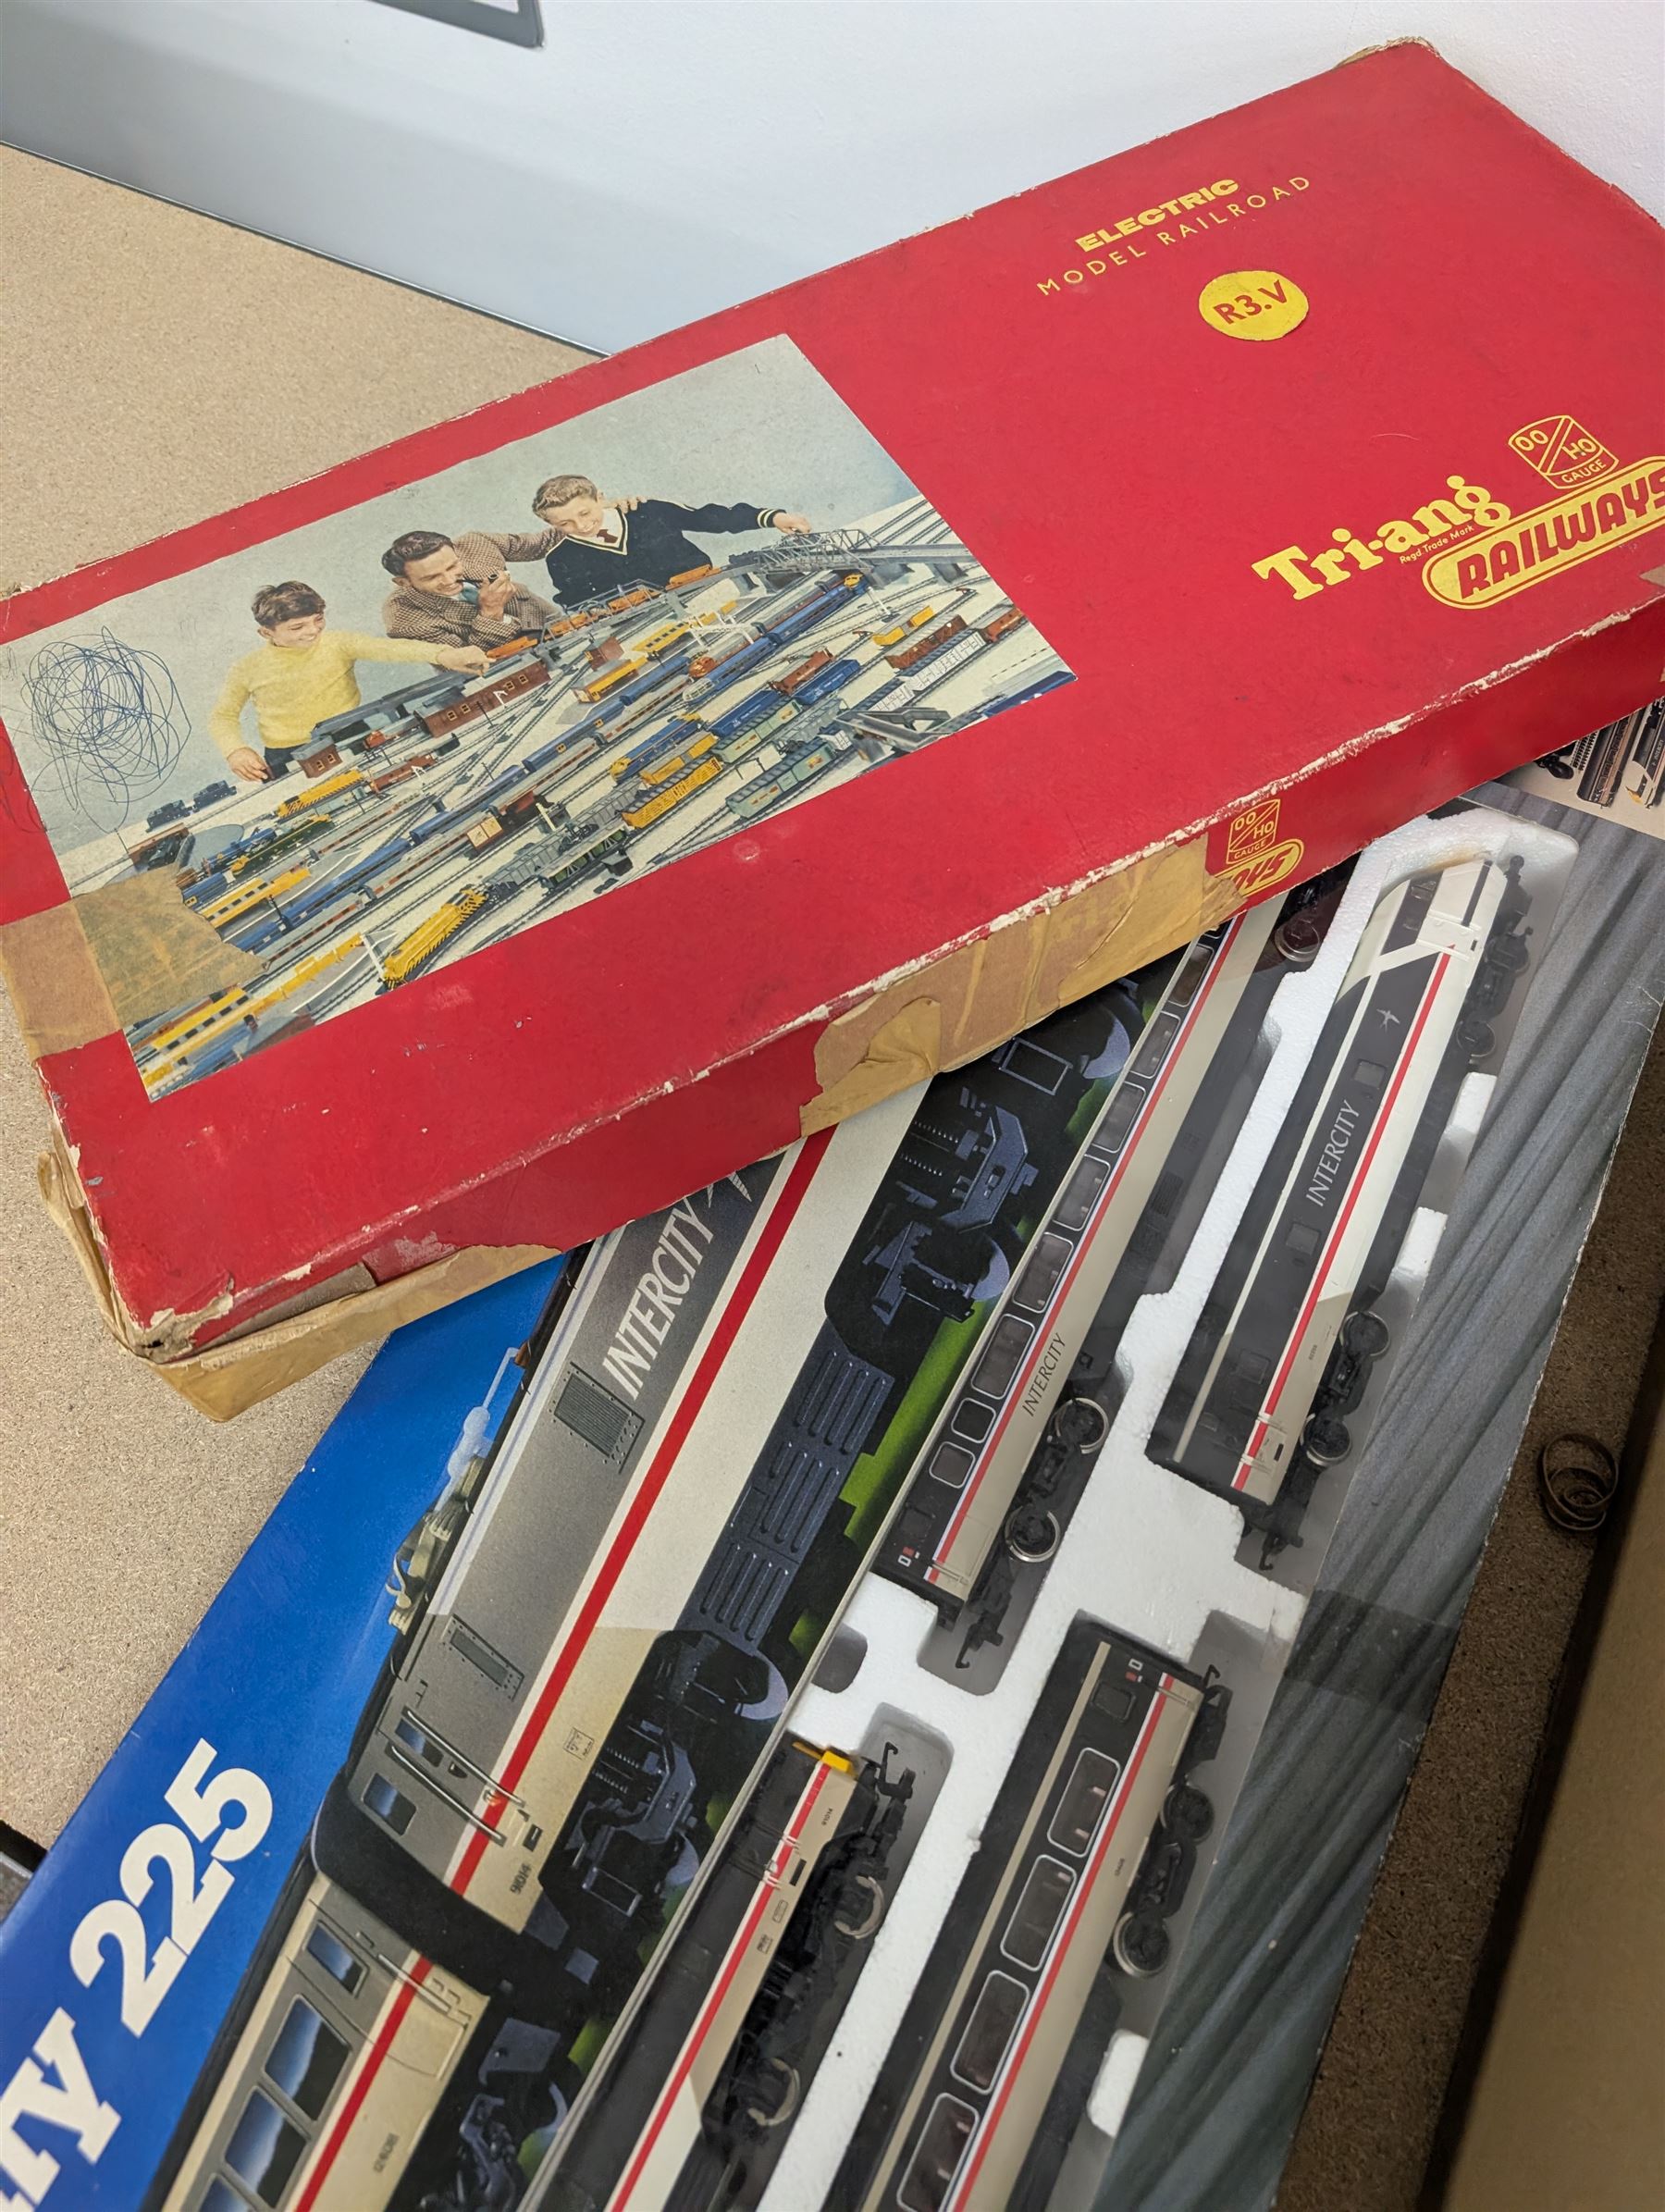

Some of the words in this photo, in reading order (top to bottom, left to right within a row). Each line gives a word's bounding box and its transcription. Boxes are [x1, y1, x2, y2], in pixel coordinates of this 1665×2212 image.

[1036, 245, 1146, 296] MODEL
[1156, 177, 1310, 245] RAILROAD
[1075, 179, 1240, 253] ELECTRIC
[1213, 279, 1288, 325] R3.V
[1560, 458, 1607, 483] GAUGE
[1561, 438, 1597, 460] HO
[1251, 475, 1511, 600] Tri-ang
[1422, 537, 1449, 553] Trade
[1449, 524, 1475, 540] Mark
[1234, 838, 1267, 859] GAUGE
[1252, 821, 1275, 839] HO
[1305, 1098, 1360, 1206] INTERCITY
[602, 1196, 714, 1402] INTERCITY
[1021, 1332, 1066, 1417] INTERCITY
[69, 1737, 273, 2037] 225
